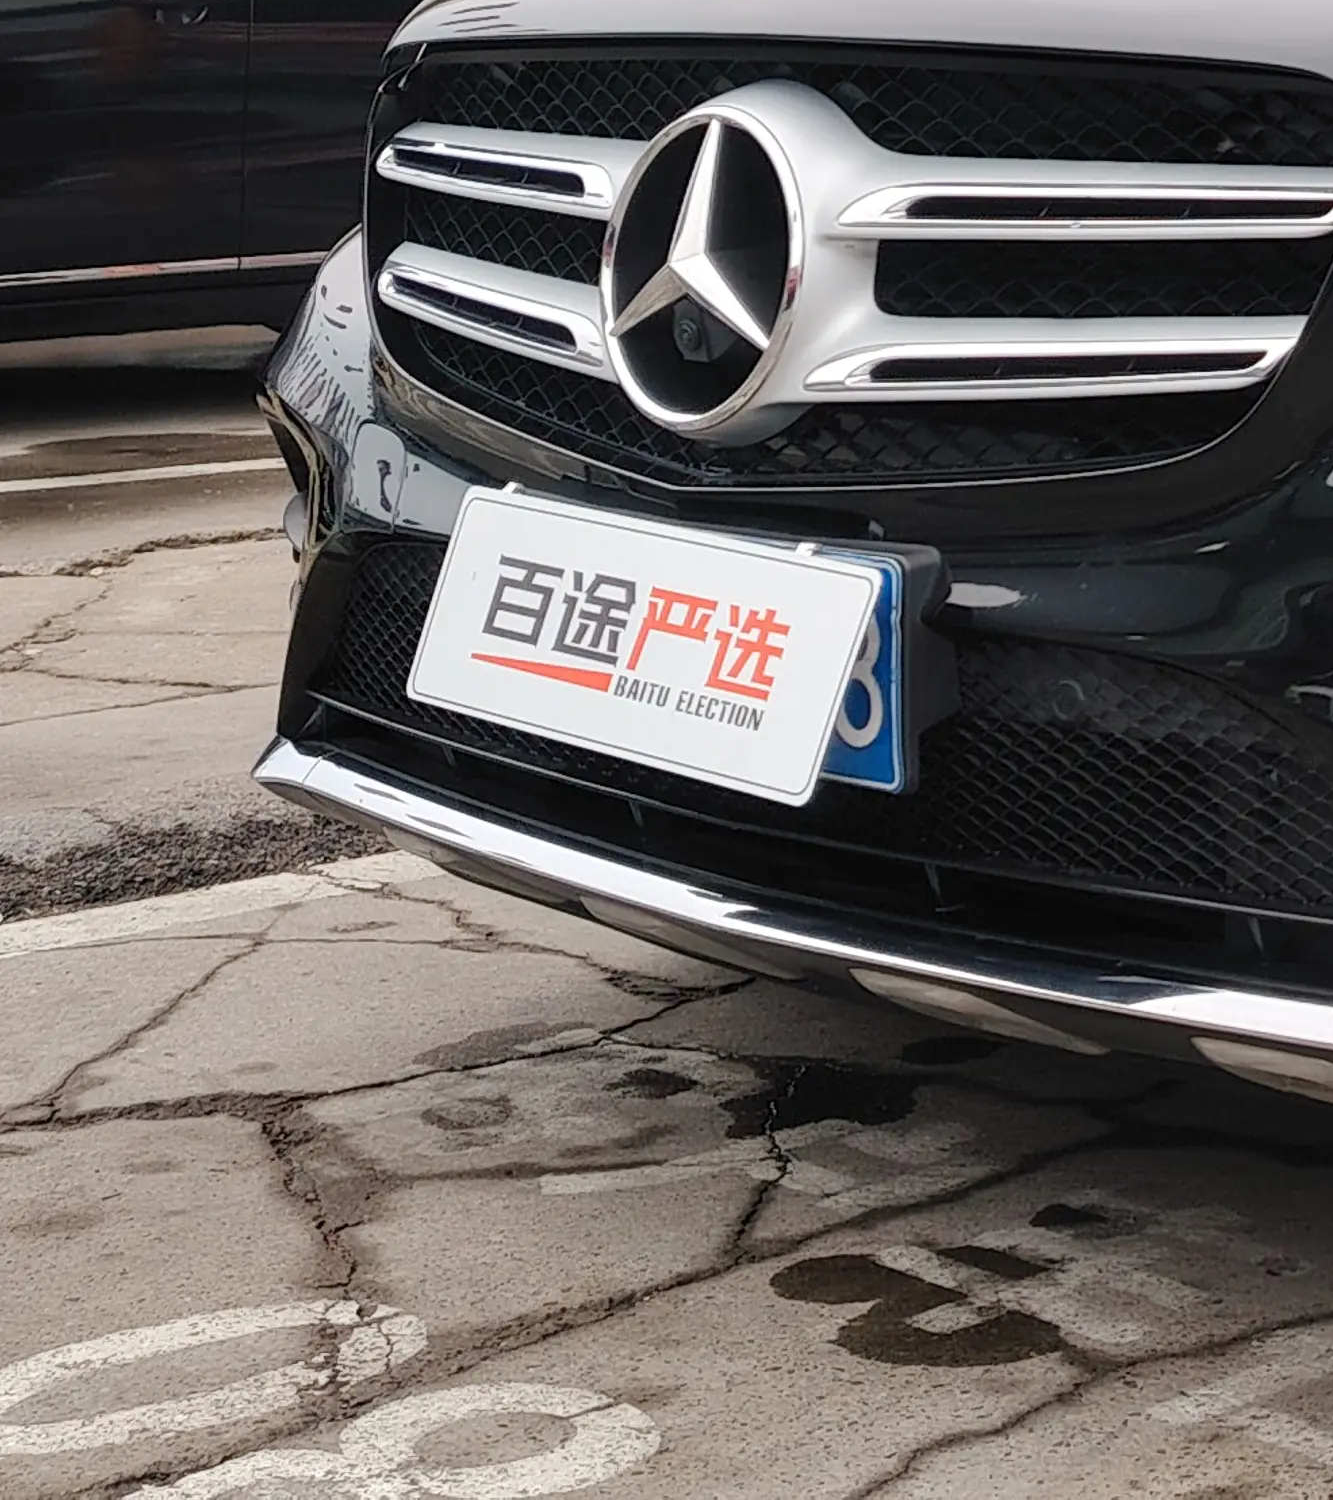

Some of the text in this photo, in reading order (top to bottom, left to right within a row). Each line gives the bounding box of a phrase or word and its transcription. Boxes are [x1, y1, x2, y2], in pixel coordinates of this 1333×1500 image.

[481, 554, 790, 701] 百途严选
[613, 675, 765, 732] BAITU ELECTION
